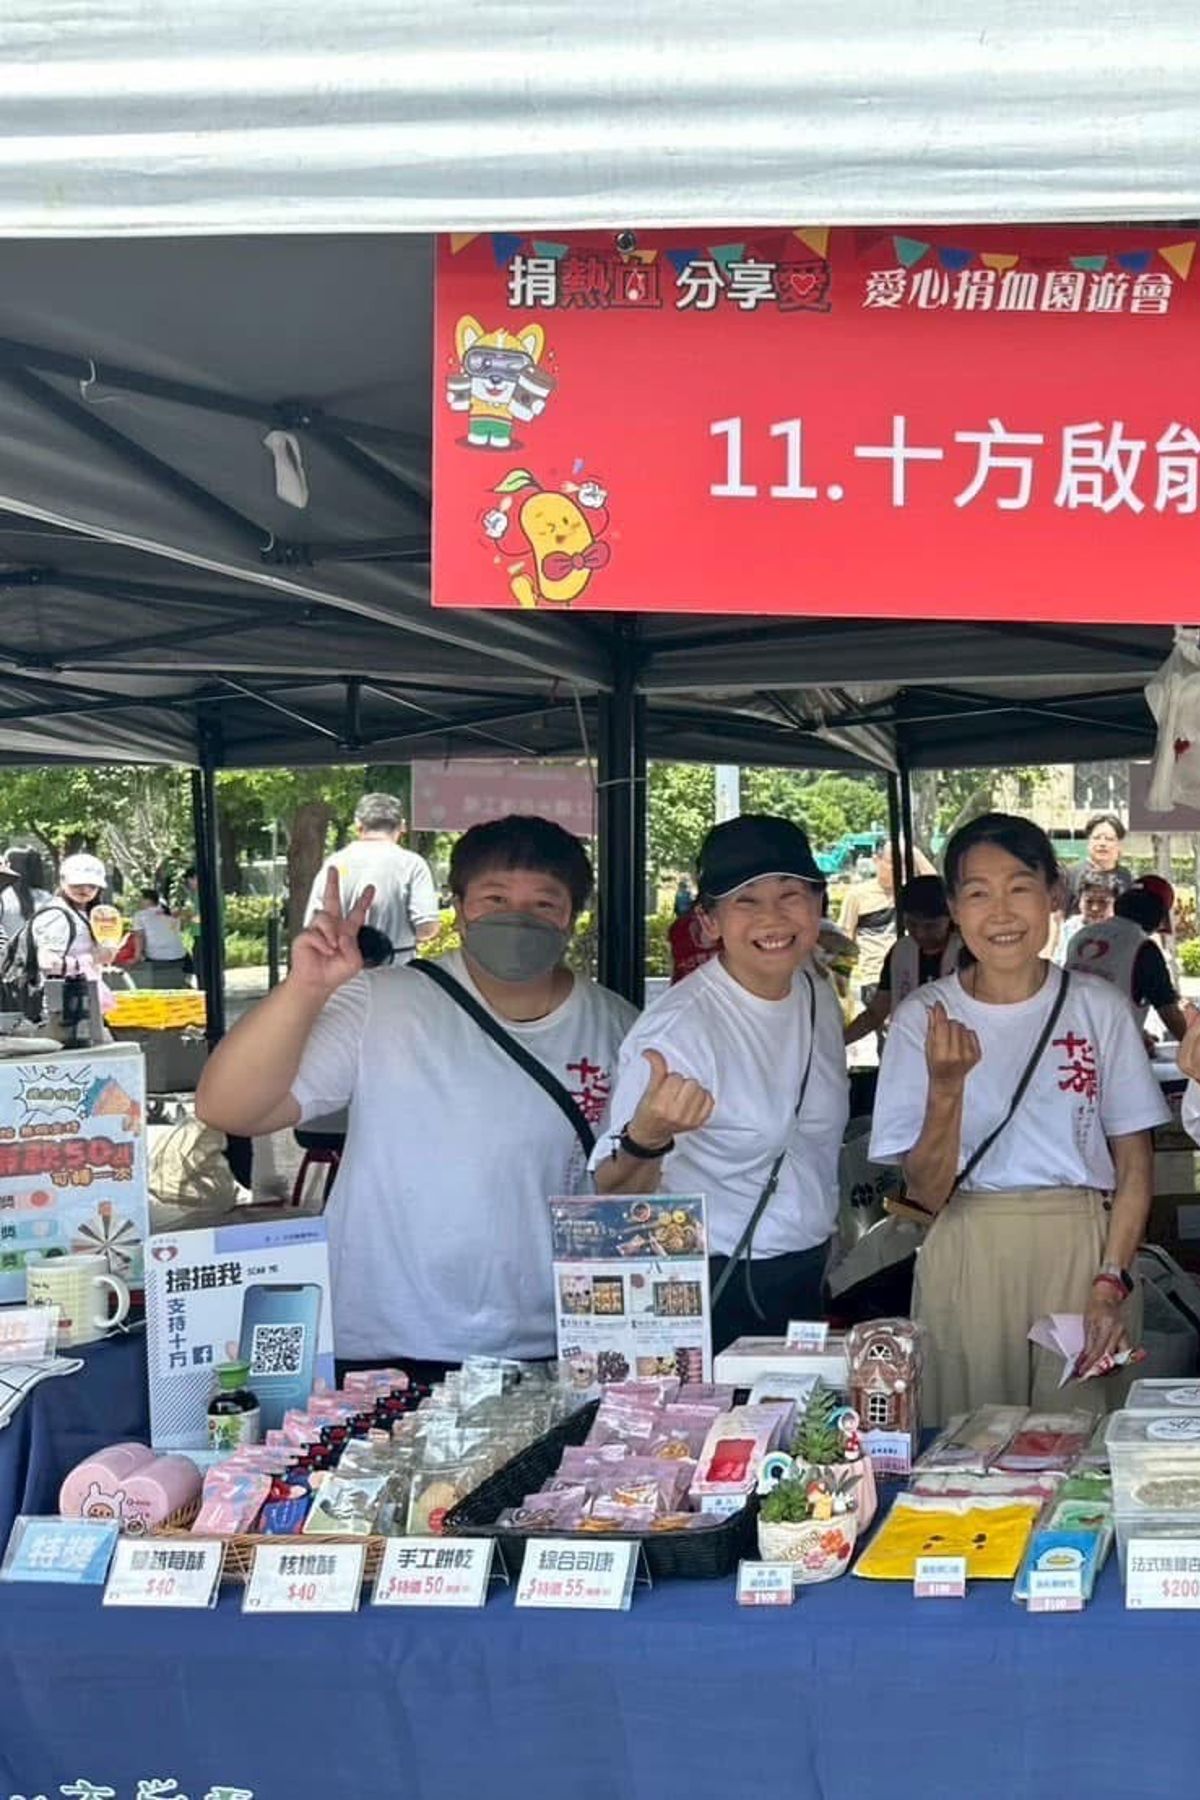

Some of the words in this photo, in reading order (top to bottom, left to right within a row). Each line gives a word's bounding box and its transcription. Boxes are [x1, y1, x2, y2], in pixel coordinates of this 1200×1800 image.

[508, 254, 664, 311] 捐熱血
[675, 258, 833, 313] 分享愛
[862, 267, 1175, 316] 愛心捐血園遊會
[165, 1262, 243, 1294] 掃描我
[167, 1298, 188, 1369] 支持十方
[397, 1547, 474, 1569] 手工餅乾
[538, 1549, 616, 1573] 綜合司康
[144, 1577, 175, 1596] $40
[1162, 1579, 1200, 1598] $200
